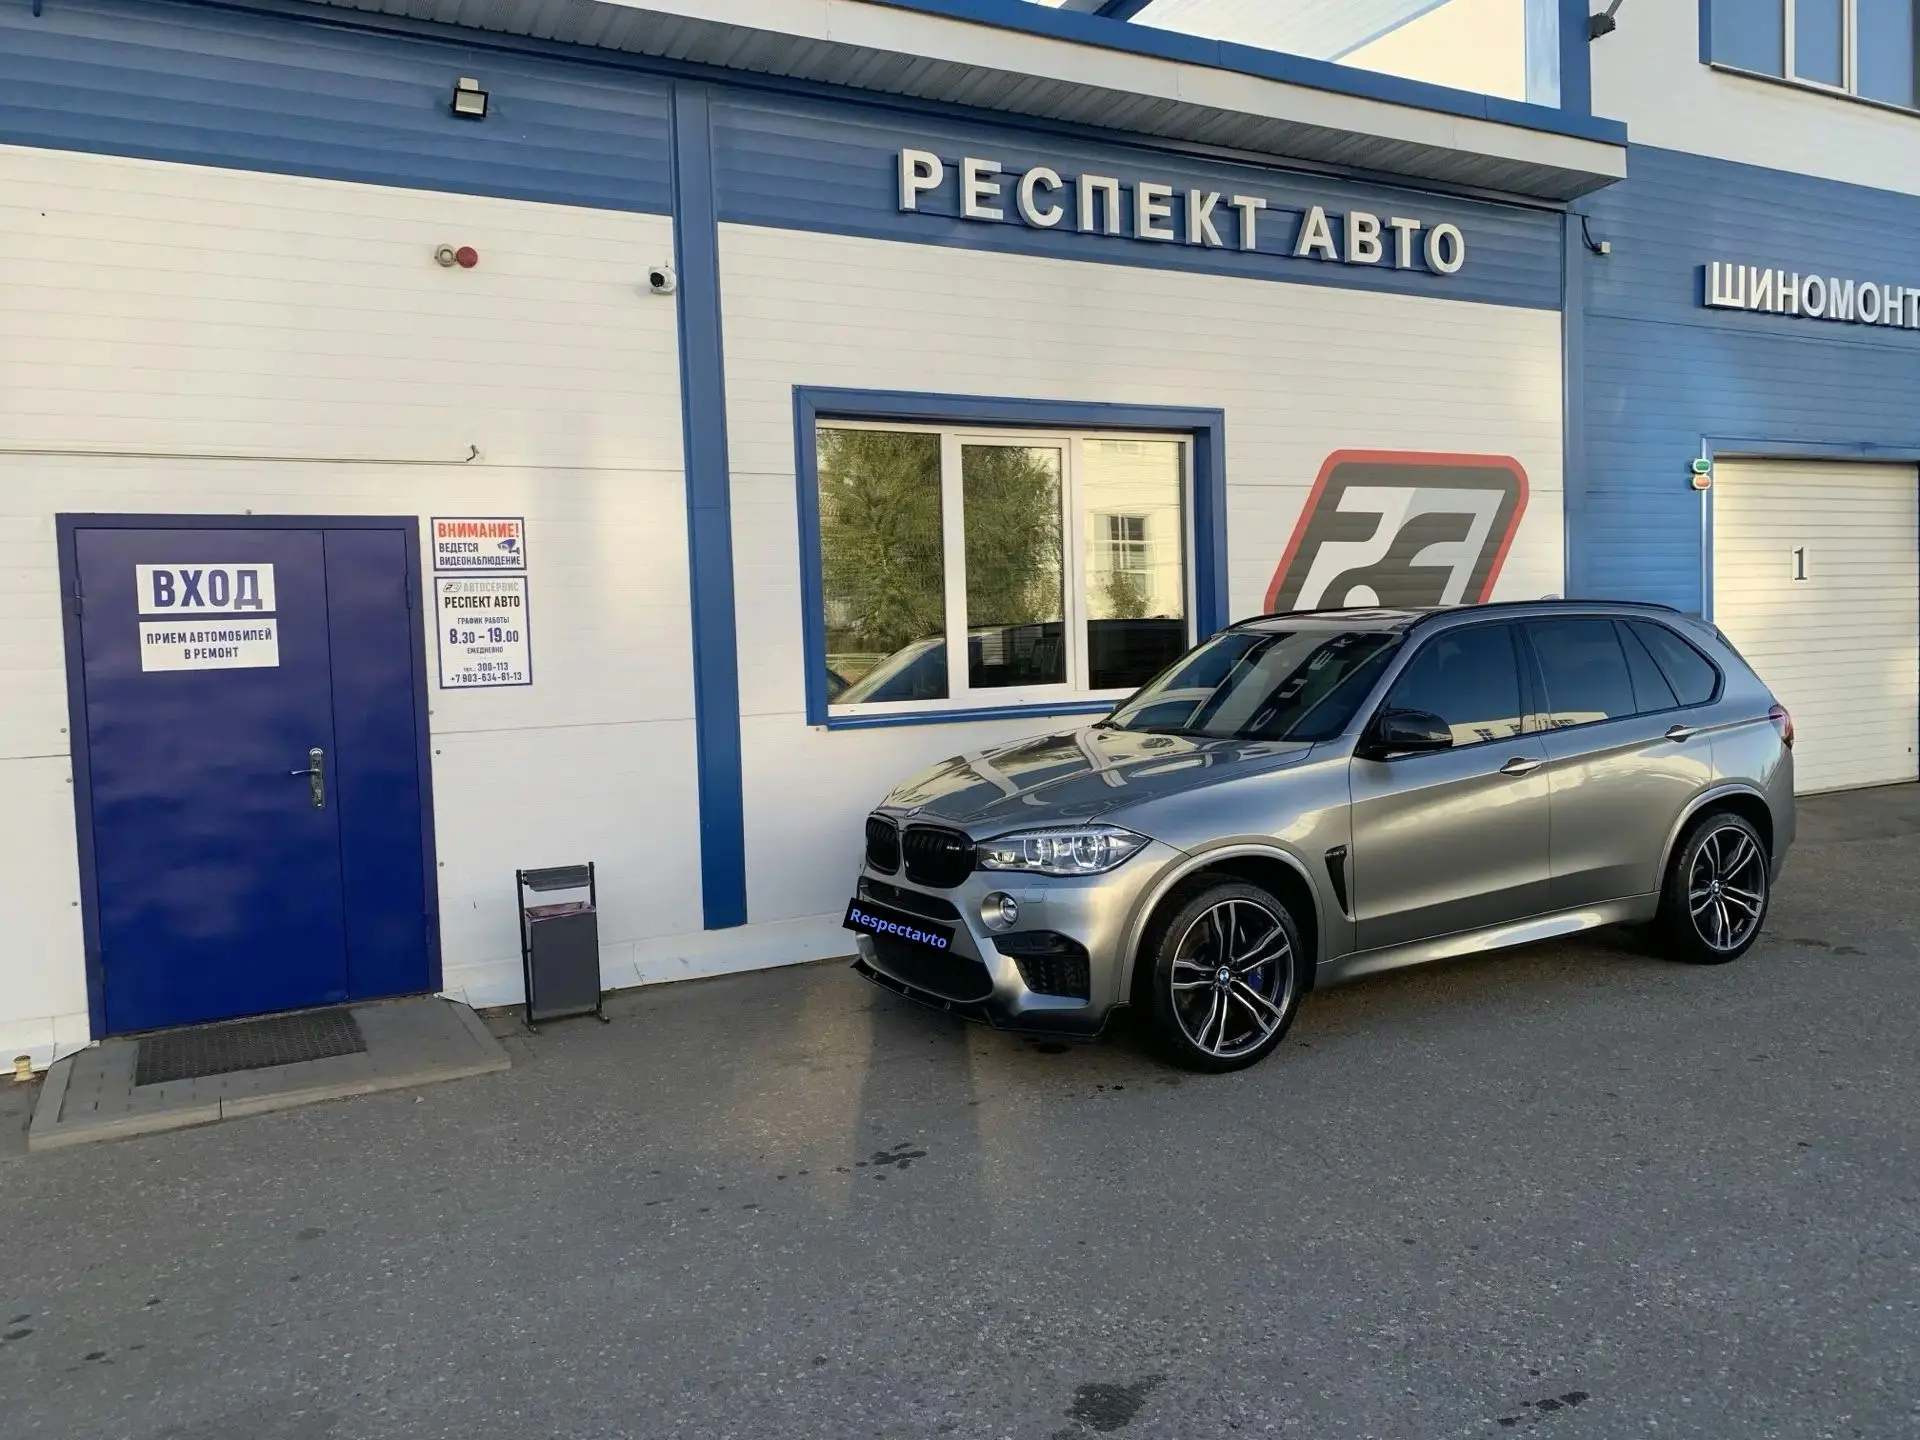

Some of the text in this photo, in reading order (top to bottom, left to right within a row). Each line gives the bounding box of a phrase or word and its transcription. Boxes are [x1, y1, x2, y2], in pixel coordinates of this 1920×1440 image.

[898, 148, 1466, 275] РЕСПЕКТ АВТО
[1704, 261, 1920, 328] ШИНОМОНТ
[438, 522, 520, 538] ВНИМАНИЕ!
[438, 542, 479, 553] ВЕДЕТСЯ
[439, 555, 521, 567] ВИДЕОНАБЛЮДЕНИЕ
[1794, 546, 1808, 581] 1
[152, 569, 263, 610] ВХОД
[463, 582, 520, 593] АВТОСЕРВИС
[444, 595, 521, 609] РЕСПЕКТ АВТО
[457, 616, 510, 625] ГРАФИК РАБОТЫ
[147, 628, 272, 645] ПРИЕМ АВТОМОБИЛЕЙ
[449, 628, 476, 645] 8.30
[487, 627, 520, 643] 19.00
[184, 647, 239, 659] В РЕМОНТ
[467, 646, 504, 654] ЕЖЕДНЕВНО
